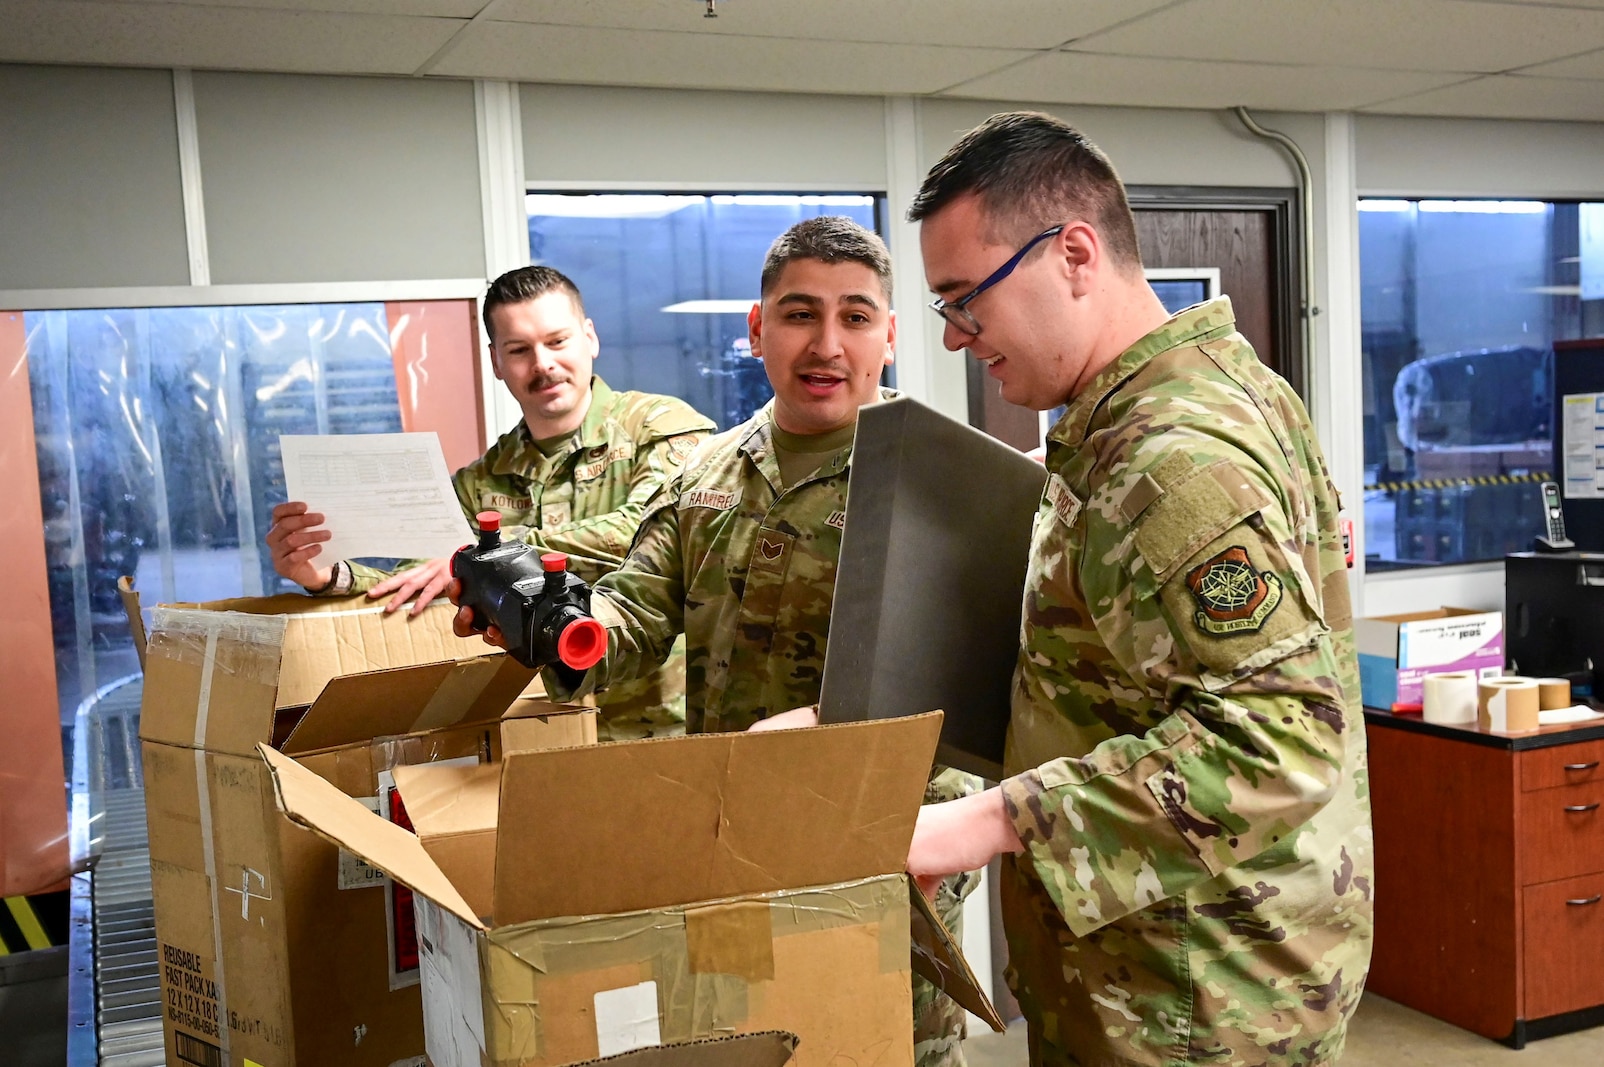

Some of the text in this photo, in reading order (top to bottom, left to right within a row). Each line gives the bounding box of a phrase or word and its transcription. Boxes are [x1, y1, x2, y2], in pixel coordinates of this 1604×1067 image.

[163, 944, 201, 973] REUSABLE
[165, 966, 183, 987] FAST
[184, 972, 205, 996] PACK
[167, 987, 177, 1006] 12
[176, 990, 183, 1009] X
[184, 994, 194, 1013] 12
[194, 997, 201, 1016] X
[201, 1001, 212, 1020] 18
